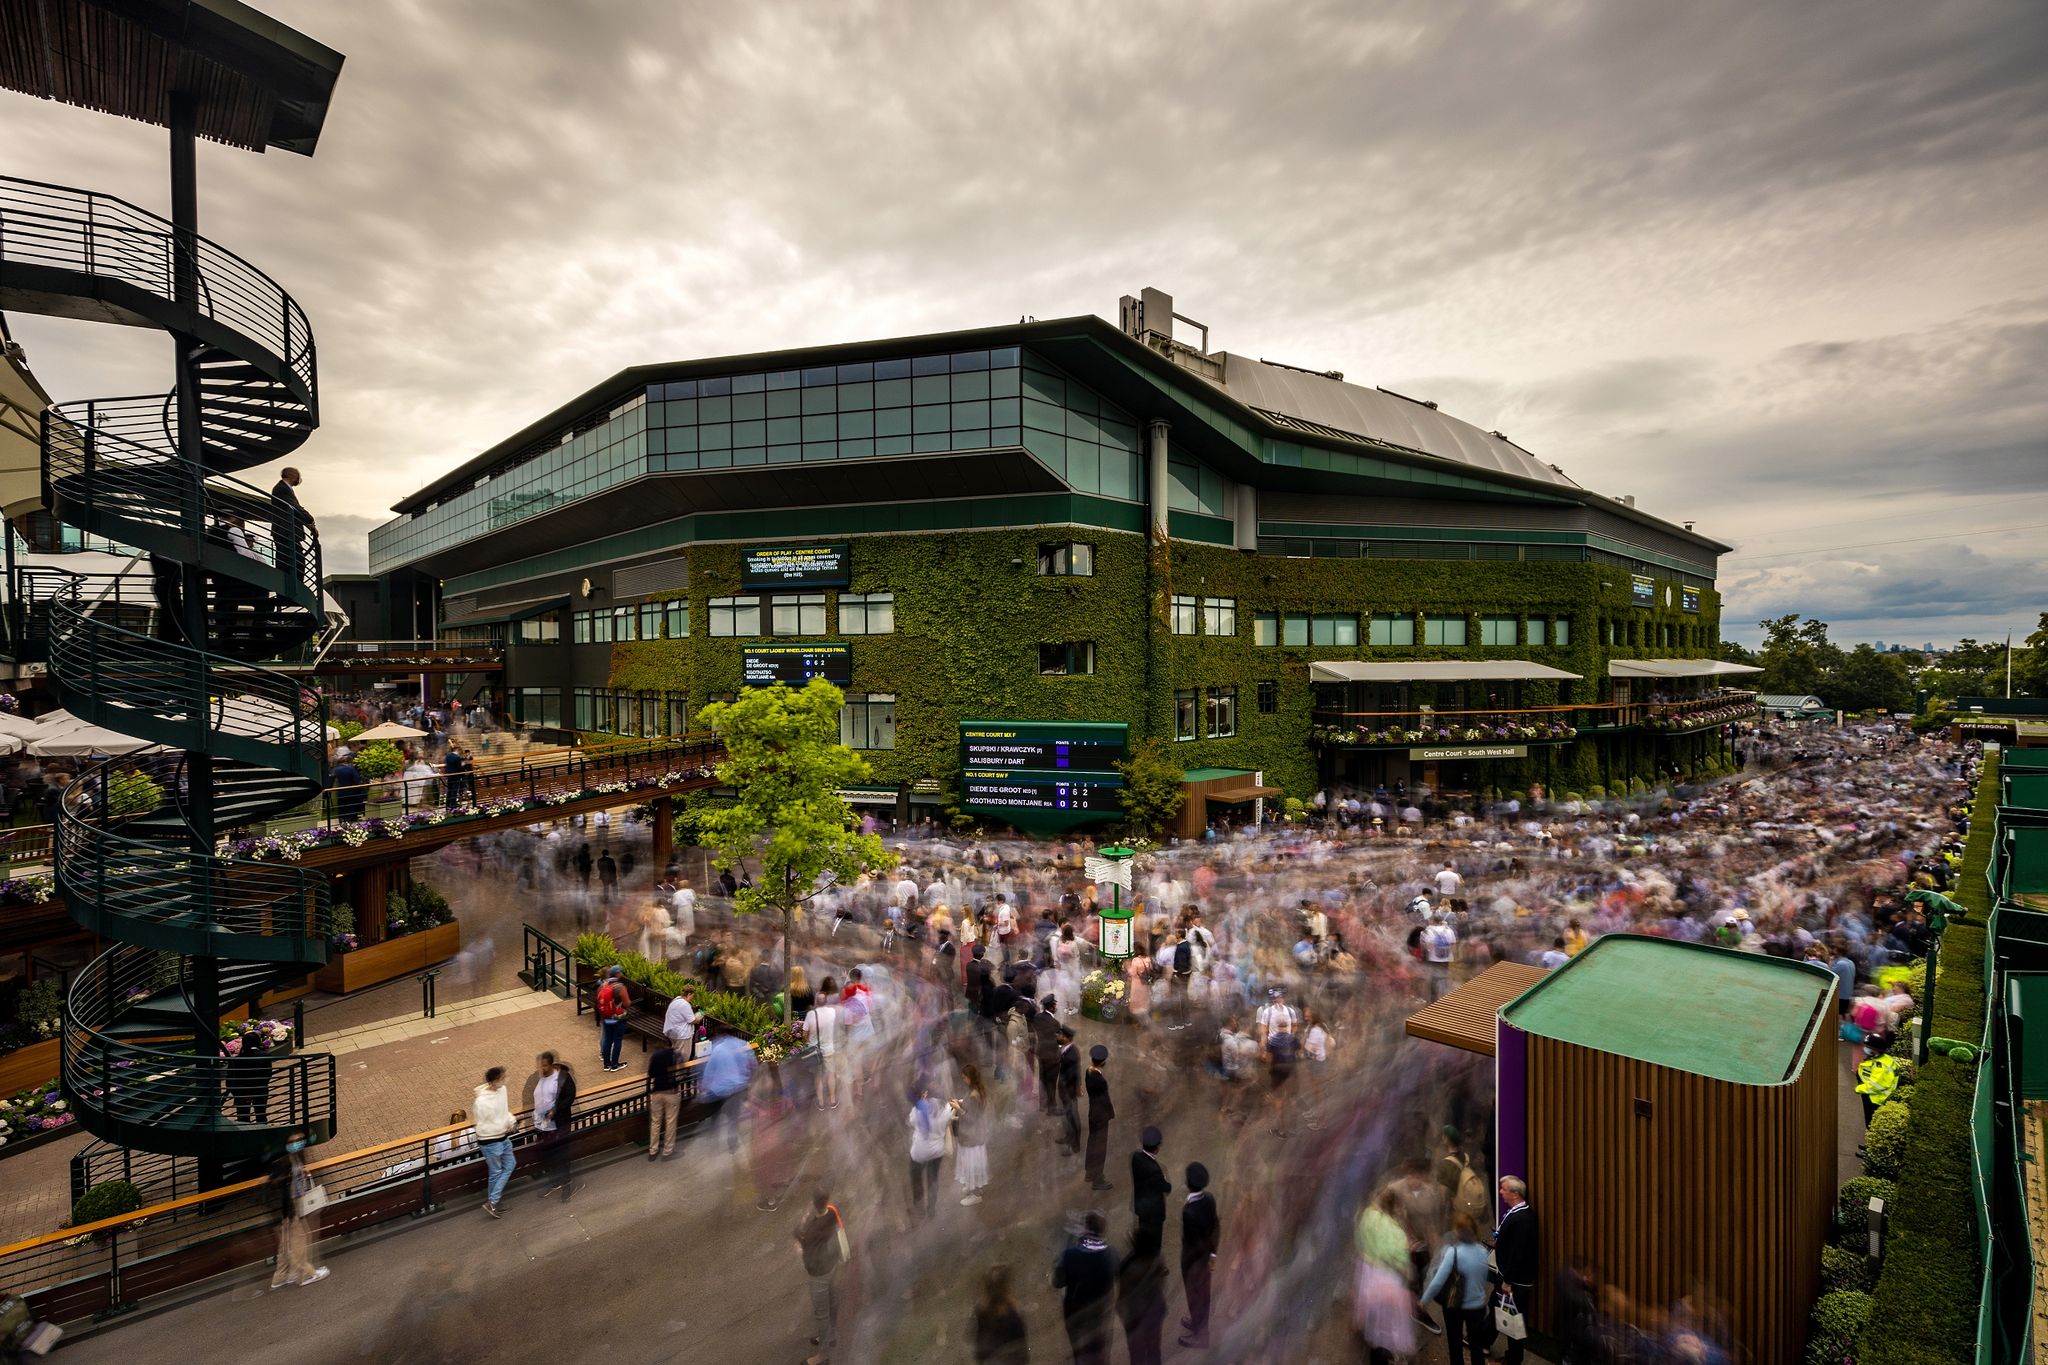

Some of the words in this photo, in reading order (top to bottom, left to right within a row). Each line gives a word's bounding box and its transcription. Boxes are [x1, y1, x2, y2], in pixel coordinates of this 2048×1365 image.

[1072, 788, 1078, 796] 6
[1083, 788, 1088, 796] 2
[1073, 800, 1078, 808] 2
